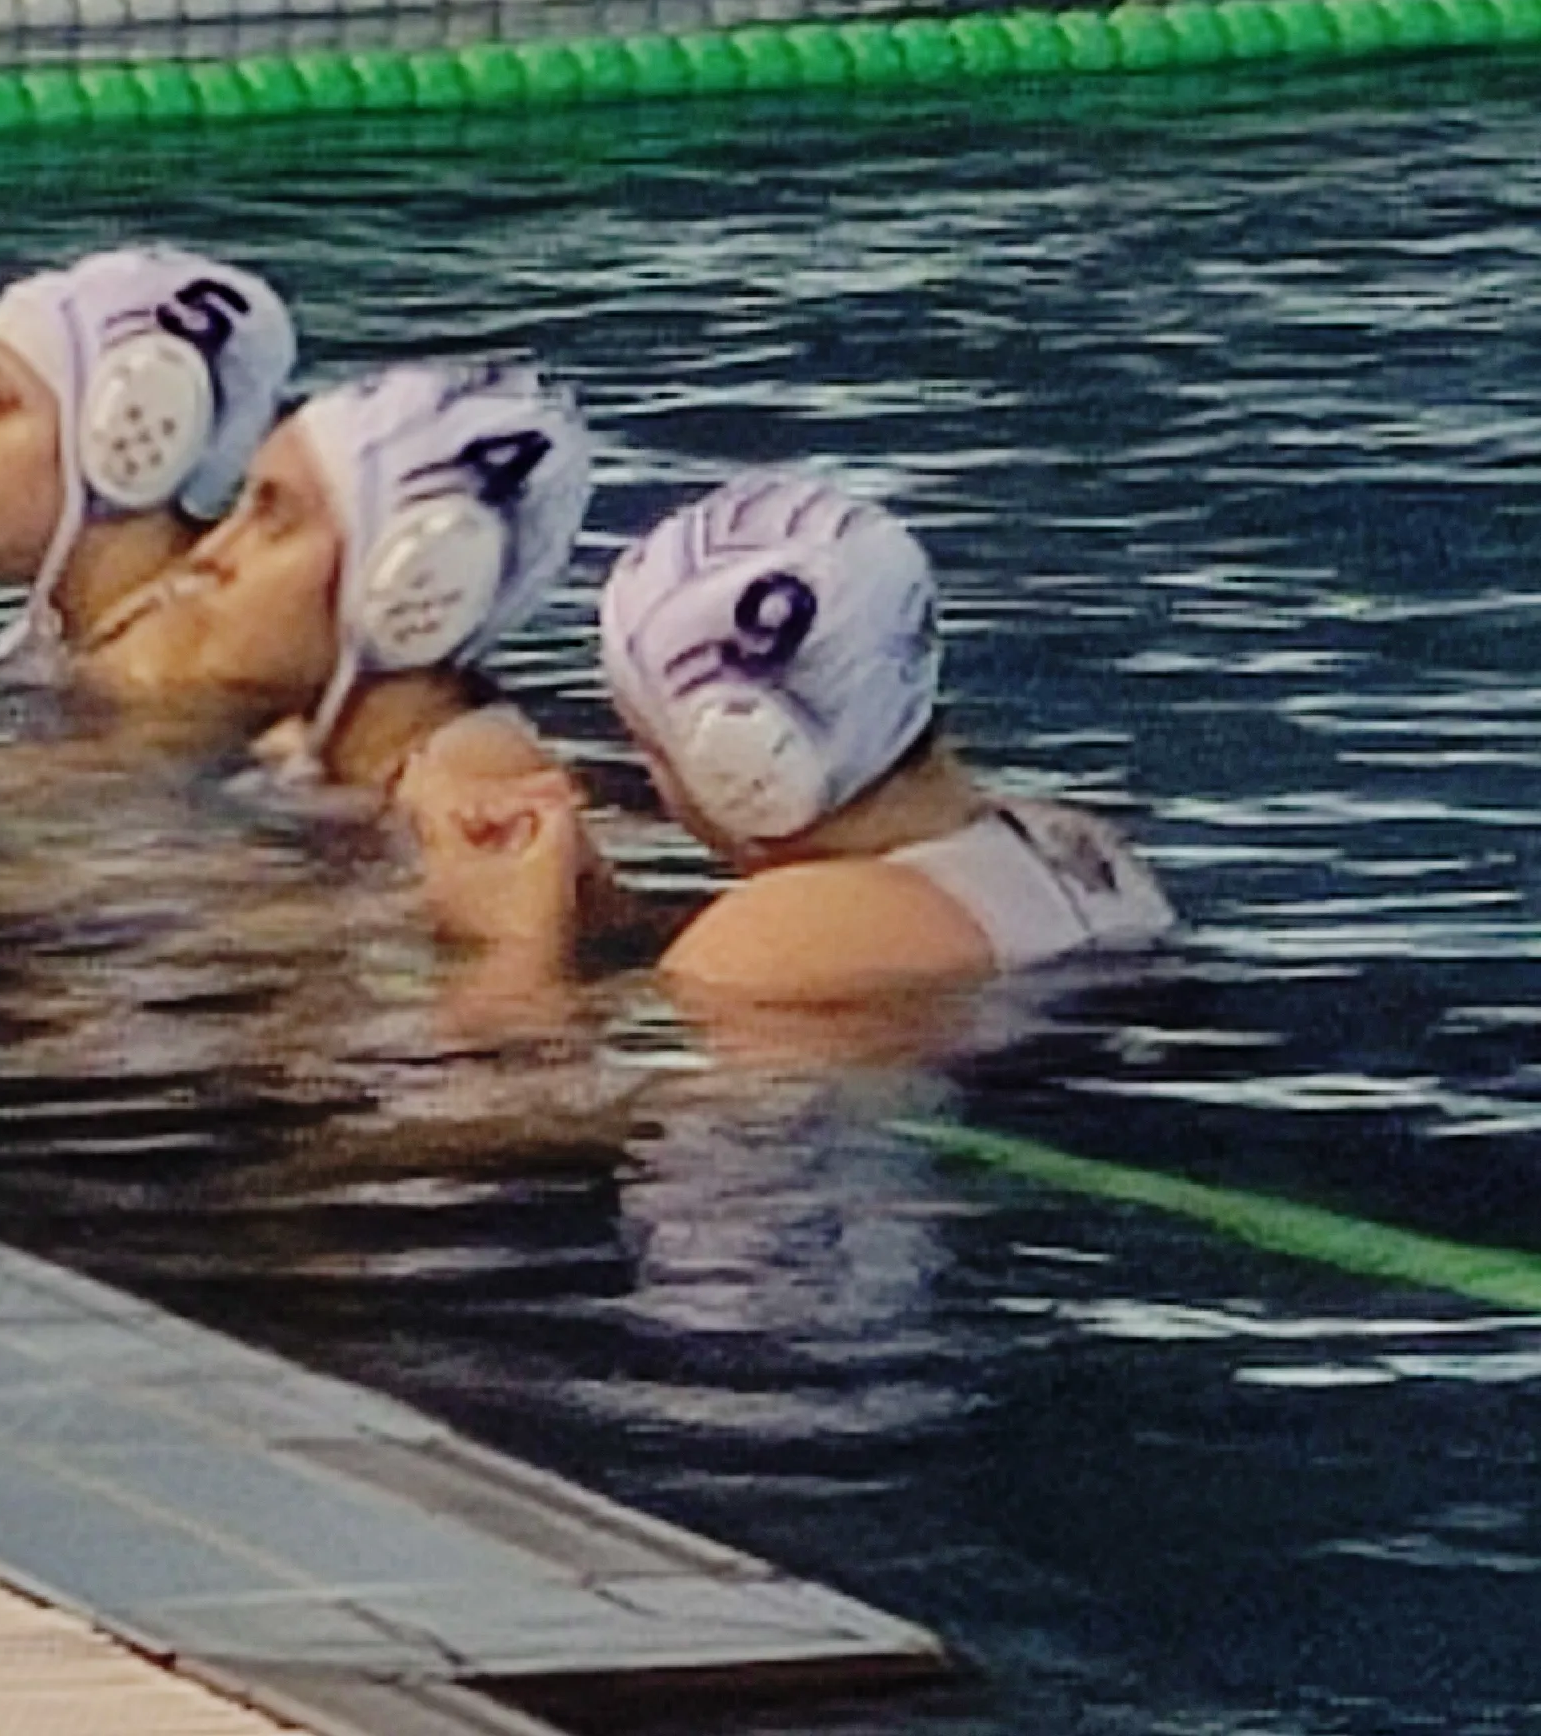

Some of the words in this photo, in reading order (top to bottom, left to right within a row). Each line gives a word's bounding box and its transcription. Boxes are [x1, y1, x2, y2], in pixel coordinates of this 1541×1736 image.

[155, 279, 251, 352] 5
[462, 430, 553, 507] 4
[720, 572, 818, 680] 9
